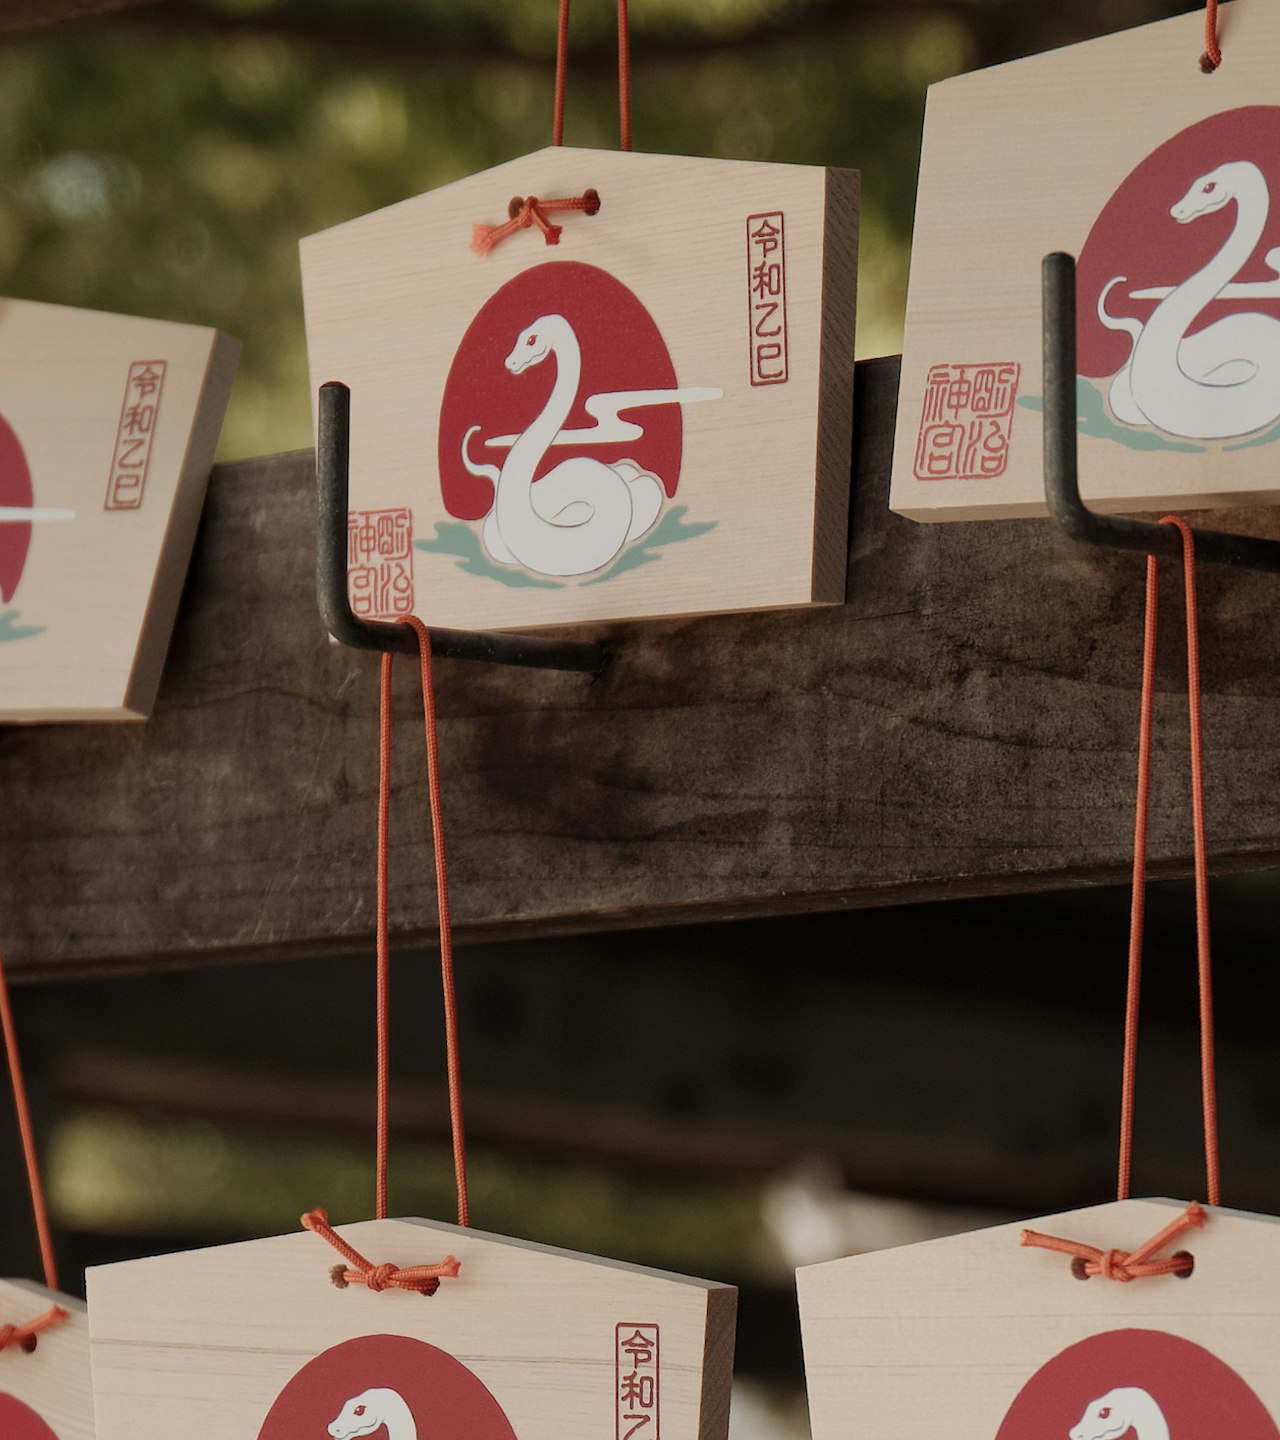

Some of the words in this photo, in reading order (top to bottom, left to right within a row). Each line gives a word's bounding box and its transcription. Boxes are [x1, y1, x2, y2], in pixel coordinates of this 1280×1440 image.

[751, 220, 783, 379] 令和乙巳
[113, 366, 160, 505] 令和乙巳
